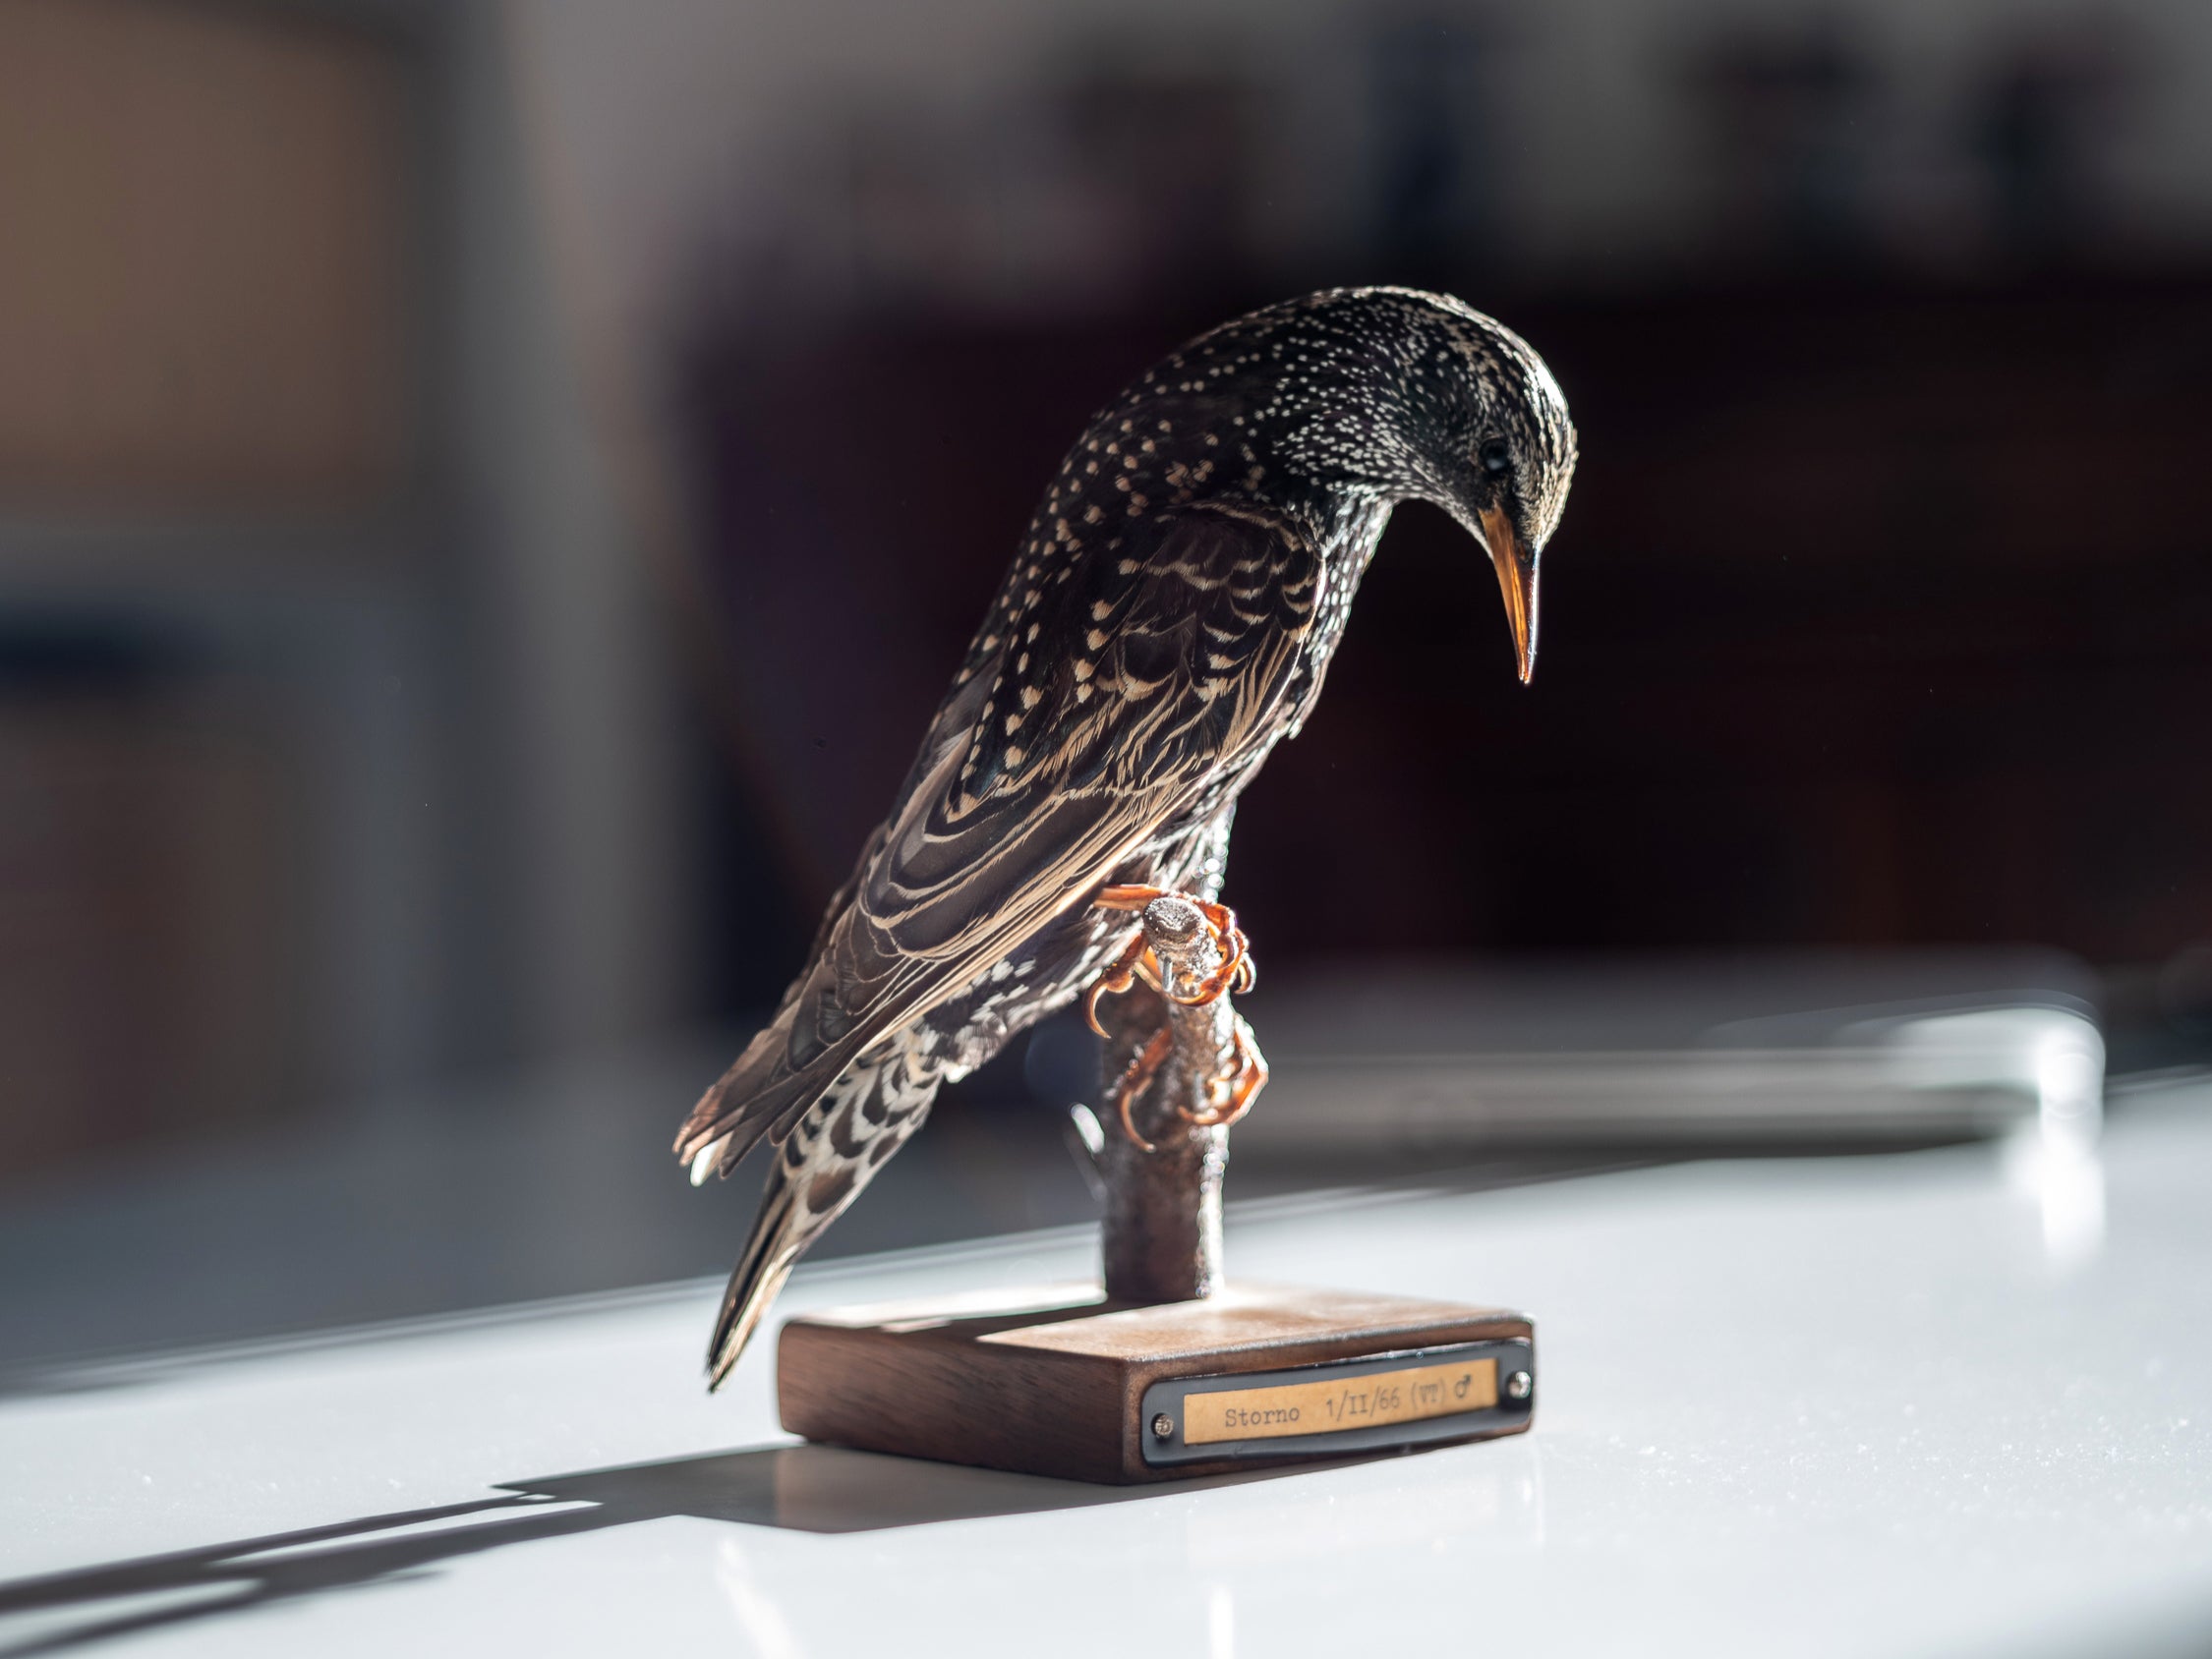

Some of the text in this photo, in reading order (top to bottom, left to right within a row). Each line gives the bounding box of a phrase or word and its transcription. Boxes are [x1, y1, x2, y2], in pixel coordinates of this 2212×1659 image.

[1225, 1378, 1446, 1429] Storno 1/II/66 (VT)
